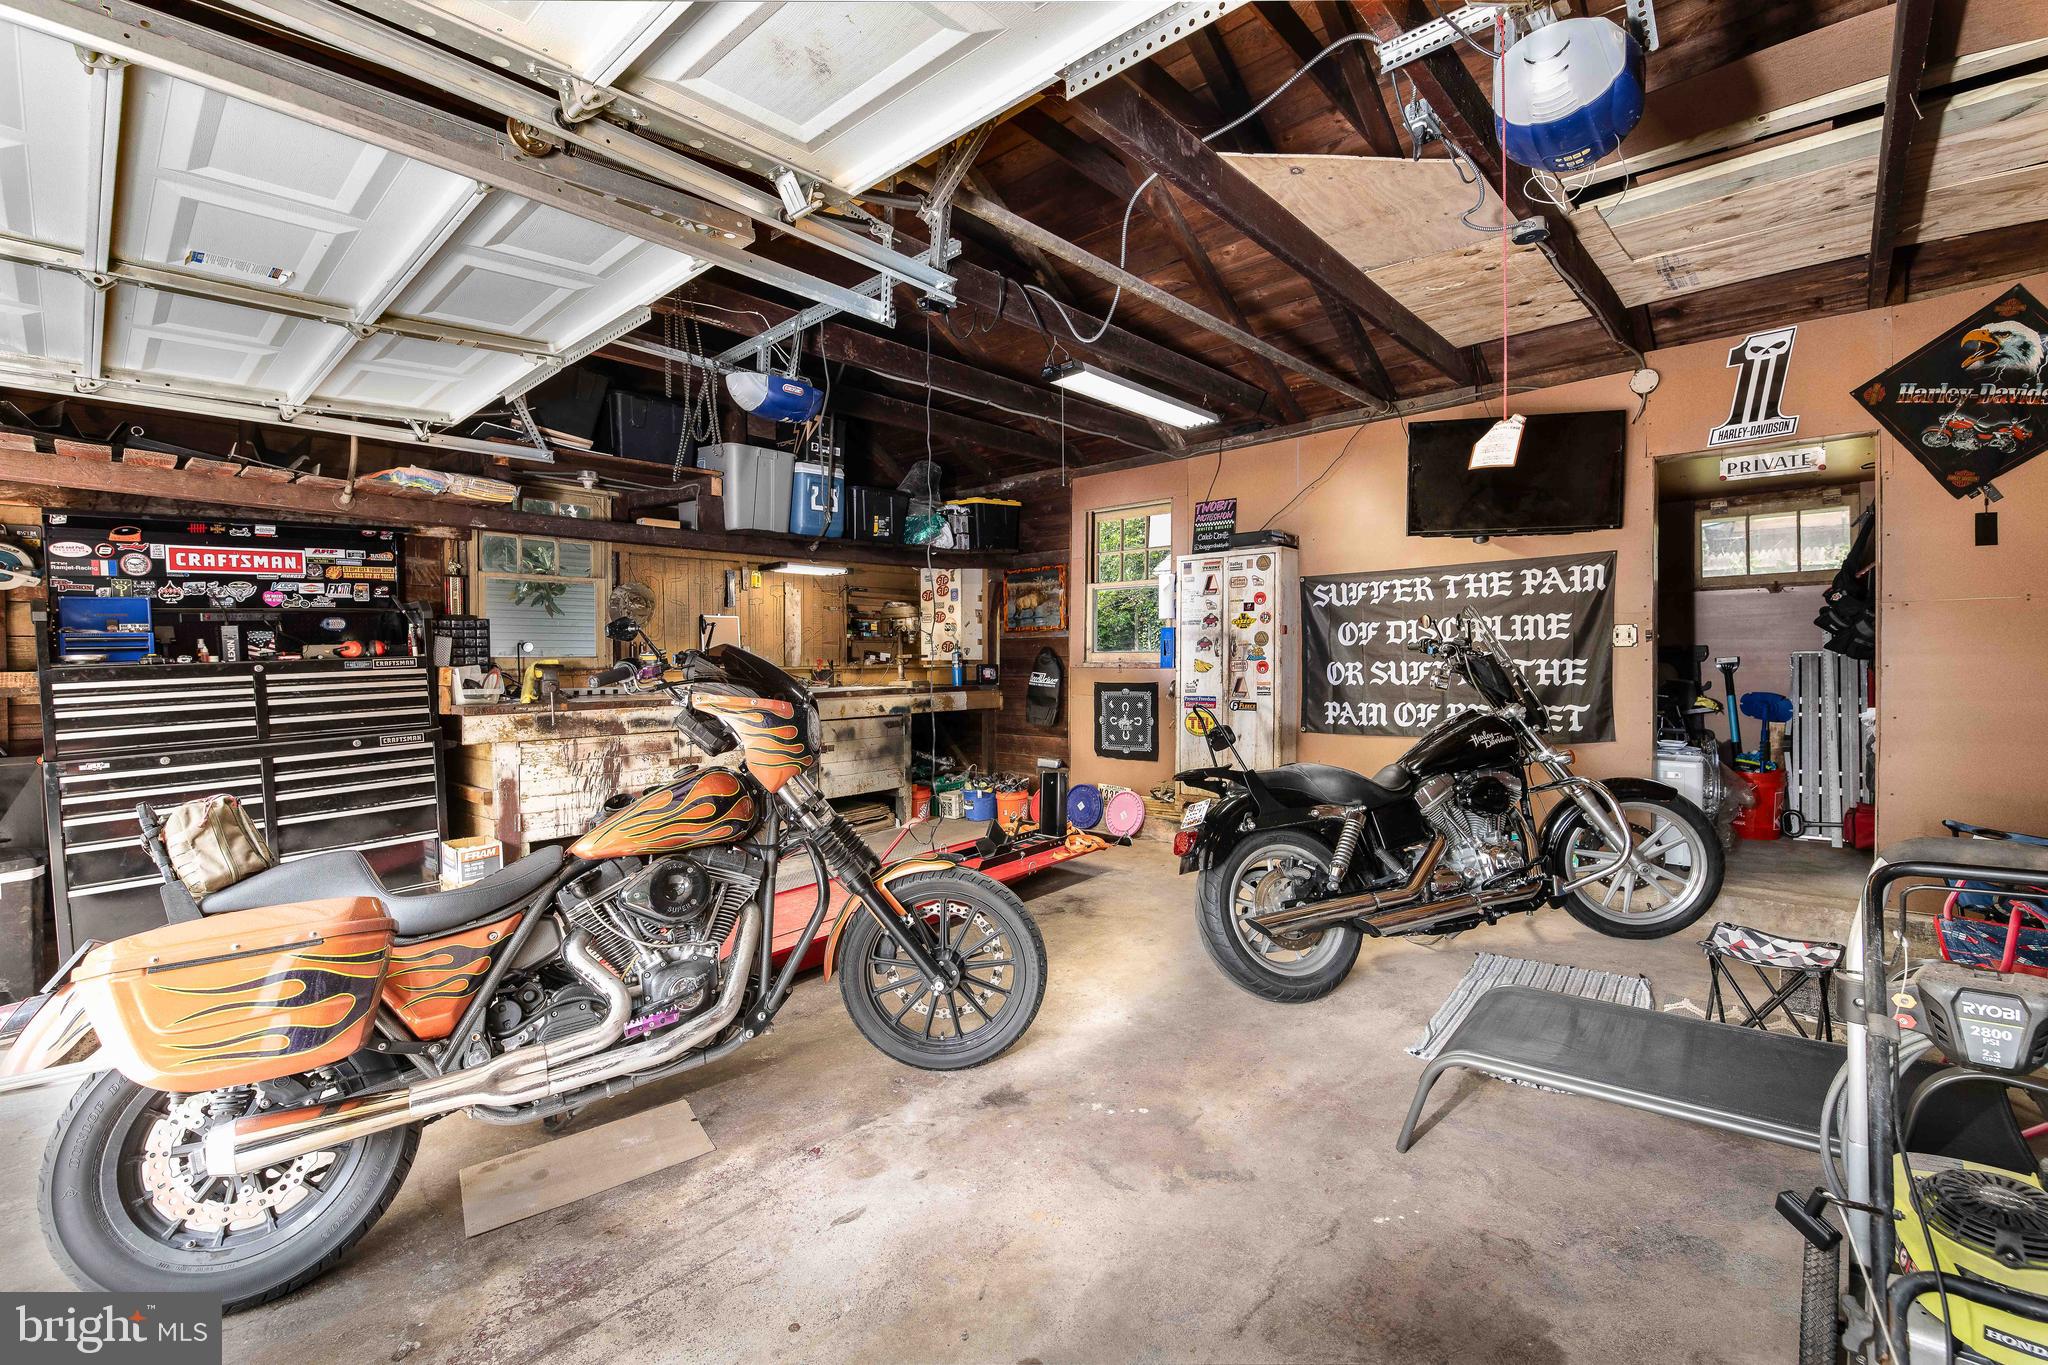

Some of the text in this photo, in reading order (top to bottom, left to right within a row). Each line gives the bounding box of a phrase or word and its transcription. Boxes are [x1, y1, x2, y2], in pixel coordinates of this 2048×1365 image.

[1718, 420, 1791, 441] HARLEY-DAVIDSON
[1727, 452, 1811, 475] PRIVATE
[1195, 500, 1236, 515] TWOBIT
[176, 552, 297, 569] CRAFTSMAN
[1312, 563, 1607, 608] SUFFER THE PAIN
[1337, 612, 1573, 647] OF DISCPLINE
[227, 640, 236, 662] LEXIN
[1326, 660, 1365, 687] OR
[1323, 701, 1388, 728] PAIN
[1393, 701, 1442, 728] OF
[382, 736, 422, 744] CRAFTSMAN
[1481, 734, 1515, 749] Davidson
[464, 848, 496, 859] FRAM
[667, 903, 692, 913] SUPER
[1961, 1001, 2021, 1022] RYOBI
[1970, 1025, 2013, 1041] 2800
[1982, 1038, 2000, 1046] PSI
[1982, 1049, 2001, 1058] 2.3
[69, 1100, 104, 1169] DUNLOP
[1985, 1329, 2048, 1358] HOND
